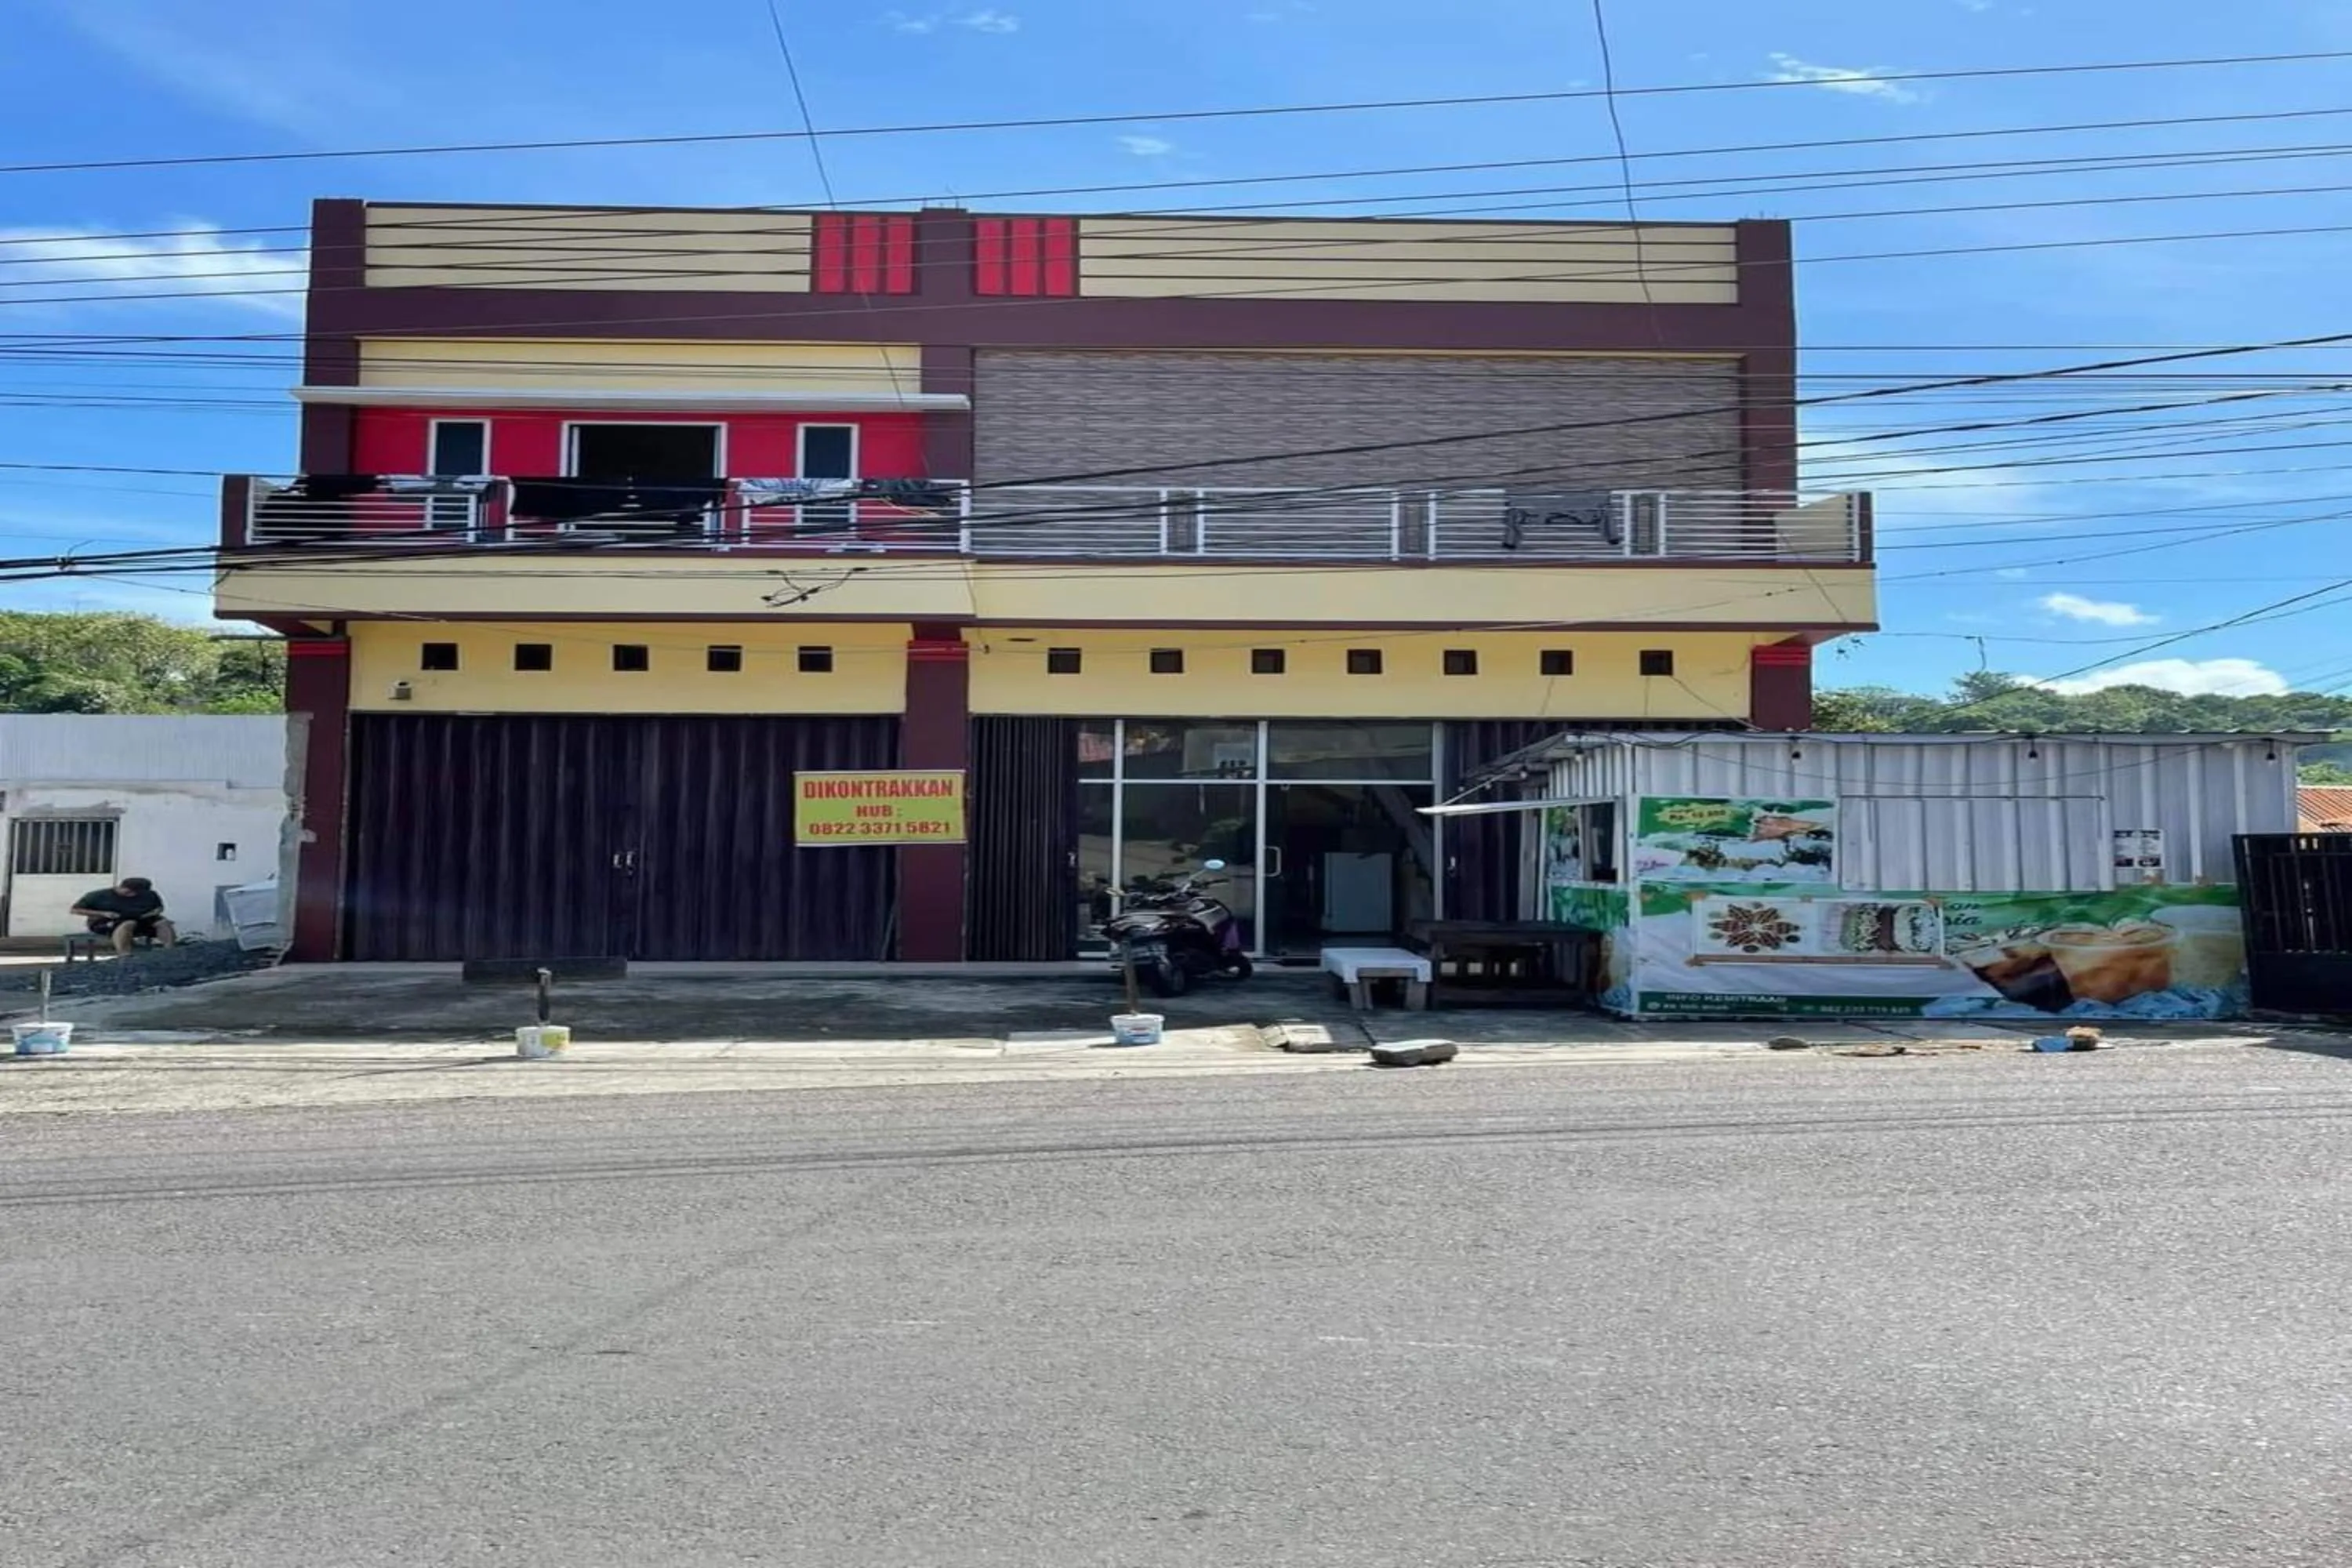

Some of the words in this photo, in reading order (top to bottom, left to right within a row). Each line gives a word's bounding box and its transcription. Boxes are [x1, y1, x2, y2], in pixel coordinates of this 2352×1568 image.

[803, 779, 953, 798] DIKONTRAKKAN
[855, 805, 893, 817] HUB
[809, 822, 855, 835] 0822
[859, 822, 901, 834] 3371
[907, 822, 950, 834] 5821
